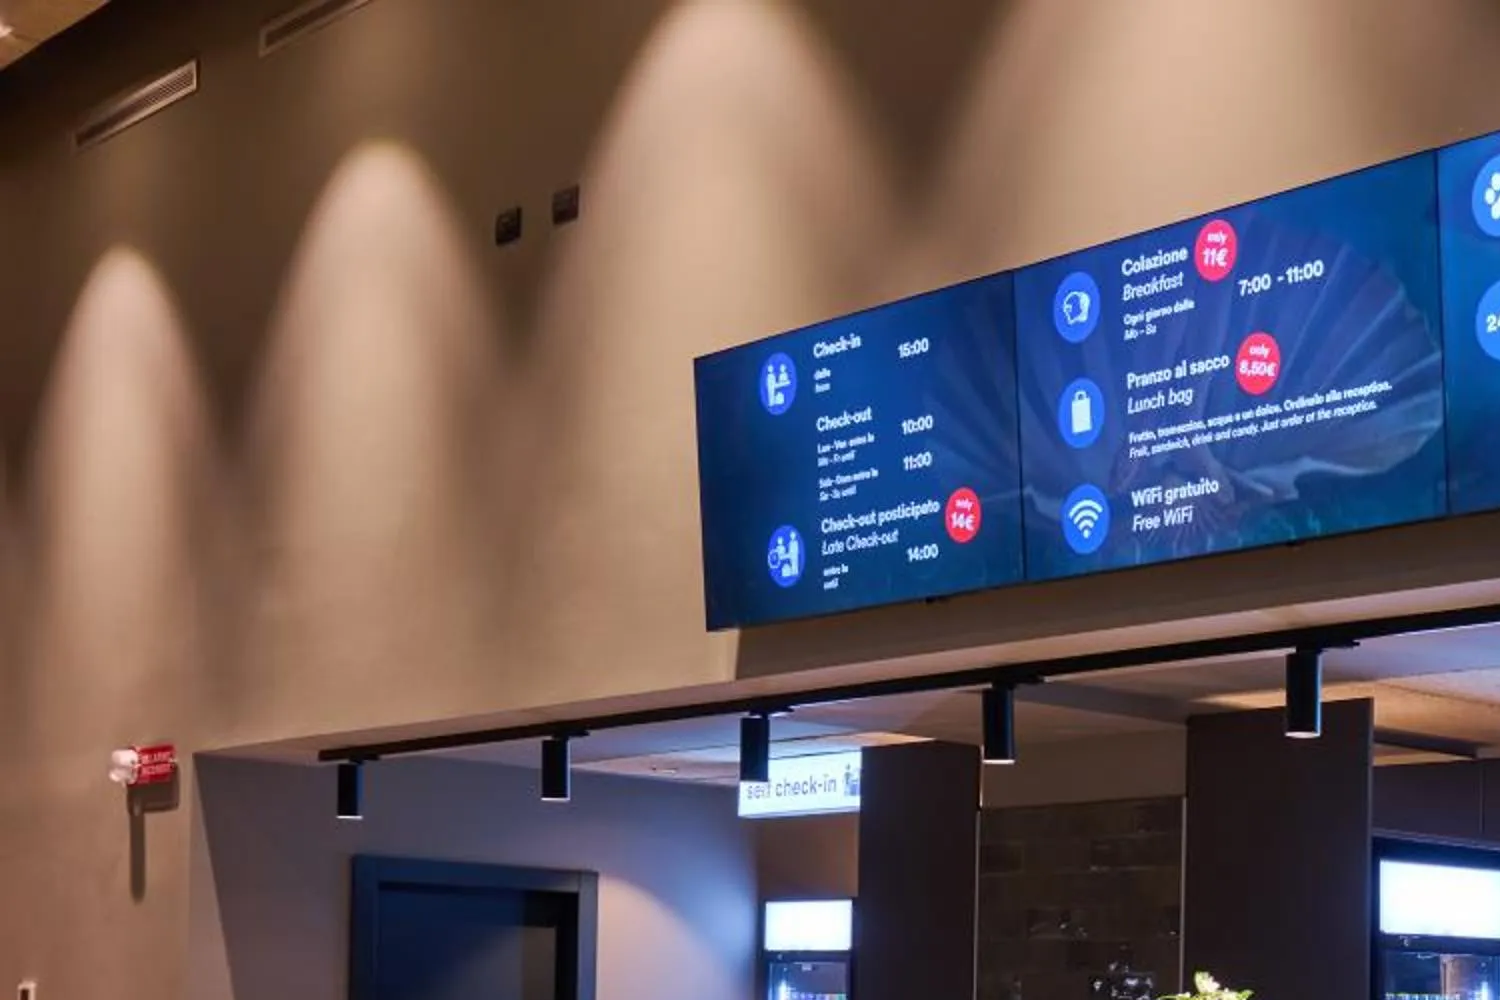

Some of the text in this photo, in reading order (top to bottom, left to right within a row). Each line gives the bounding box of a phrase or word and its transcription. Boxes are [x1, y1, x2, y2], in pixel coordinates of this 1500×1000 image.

[1206, 231, 1228, 246] only
[1121, 246, 1189, 277] Colazione
[1202, 246, 1228, 268] 11€
[1122, 271, 1184, 302] Breakfast
[1238, 273, 1272, 298] 7:00
[1286, 260, 1325, 284] 11:00
[1146, 304, 1173, 324] giorno
[813, 333, 862, 360] Check-in
[898, 337, 930, 360] 15:00
[1126, 354, 1230, 390] Pranzo al sacco
[1126, 386, 1194, 414] Lunch bag
[816, 406, 873, 432] Check-out
[901, 415, 934, 435] 10:00
[903, 451, 932, 471] 11:00
[1131, 477, 1219, 508] WiFi gratuito
[821, 499, 941, 534] Check-out posticipato
[950, 513, 975, 531] 14€
[1132, 504, 1194, 533] Free WiFi
[821, 529, 899, 556] Late Check-out
[906, 543, 939, 563] 14:00
[775, 774, 837, 798] check-in
